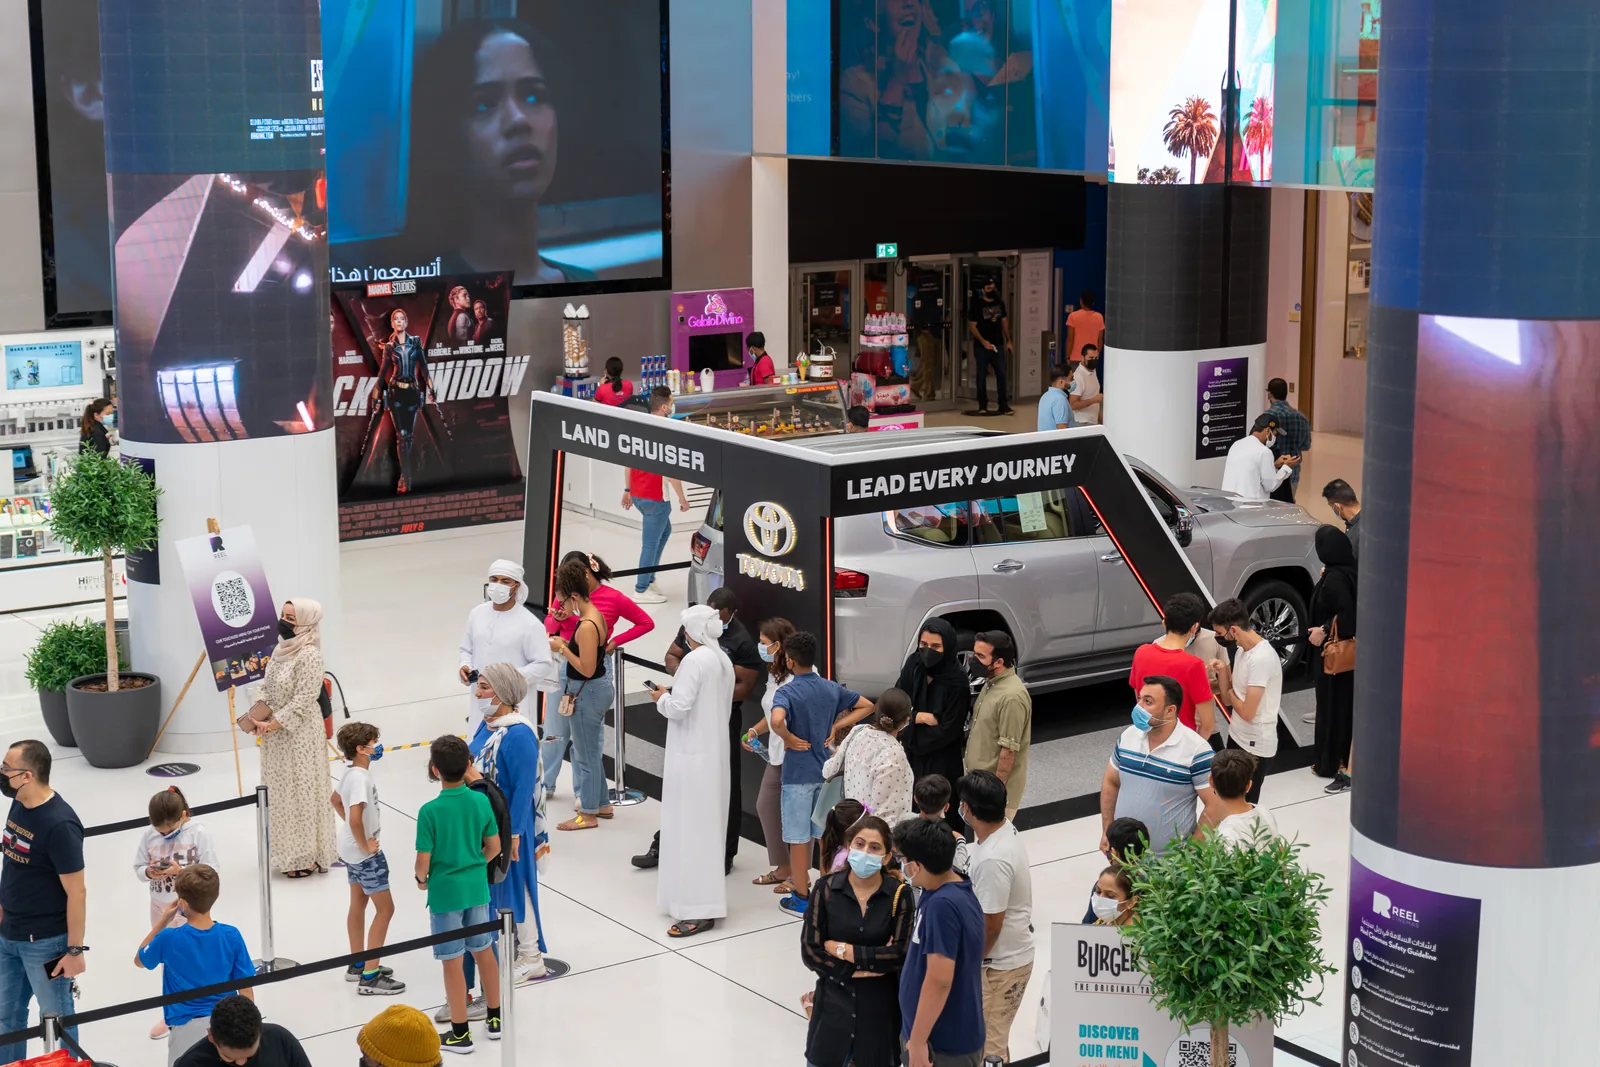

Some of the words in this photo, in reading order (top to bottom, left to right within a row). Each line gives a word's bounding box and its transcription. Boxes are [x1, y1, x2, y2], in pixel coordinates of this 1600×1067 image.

[368, 283, 391, 296] MARVEL
[392, 281, 416, 293] STUDIOS
[425, 355, 530, 404] WIDOW
[561, 420, 610, 449] LAND
[617, 433, 705, 472] CRUISER
[847, 473, 905, 500] LEAD
[909, 465, 978, 493] EVERY
[980, 453, 1076, 484] JOURNEY
[400, 522, 418, 533] JULY
[418, 521, 425, 532] 8
[735, 553, 805, 592] TOYOTA
[1392, 906, 1420, 922] REEL
[1368, 931, 1388, 946] Cinemas
[1388, 940, 1407, 954] Safety
[1407, 947, 1437, 961] Guideline
[1074, 982, 1089, 992] THE
[1094, 983, 1136, 994] ORIGINAL
[1078, 1023, 1139, 1041] DISCOVER
[1079, 1043, 1103, 1059] OUR
[1105, 1044, 1139, 1061] MENU
